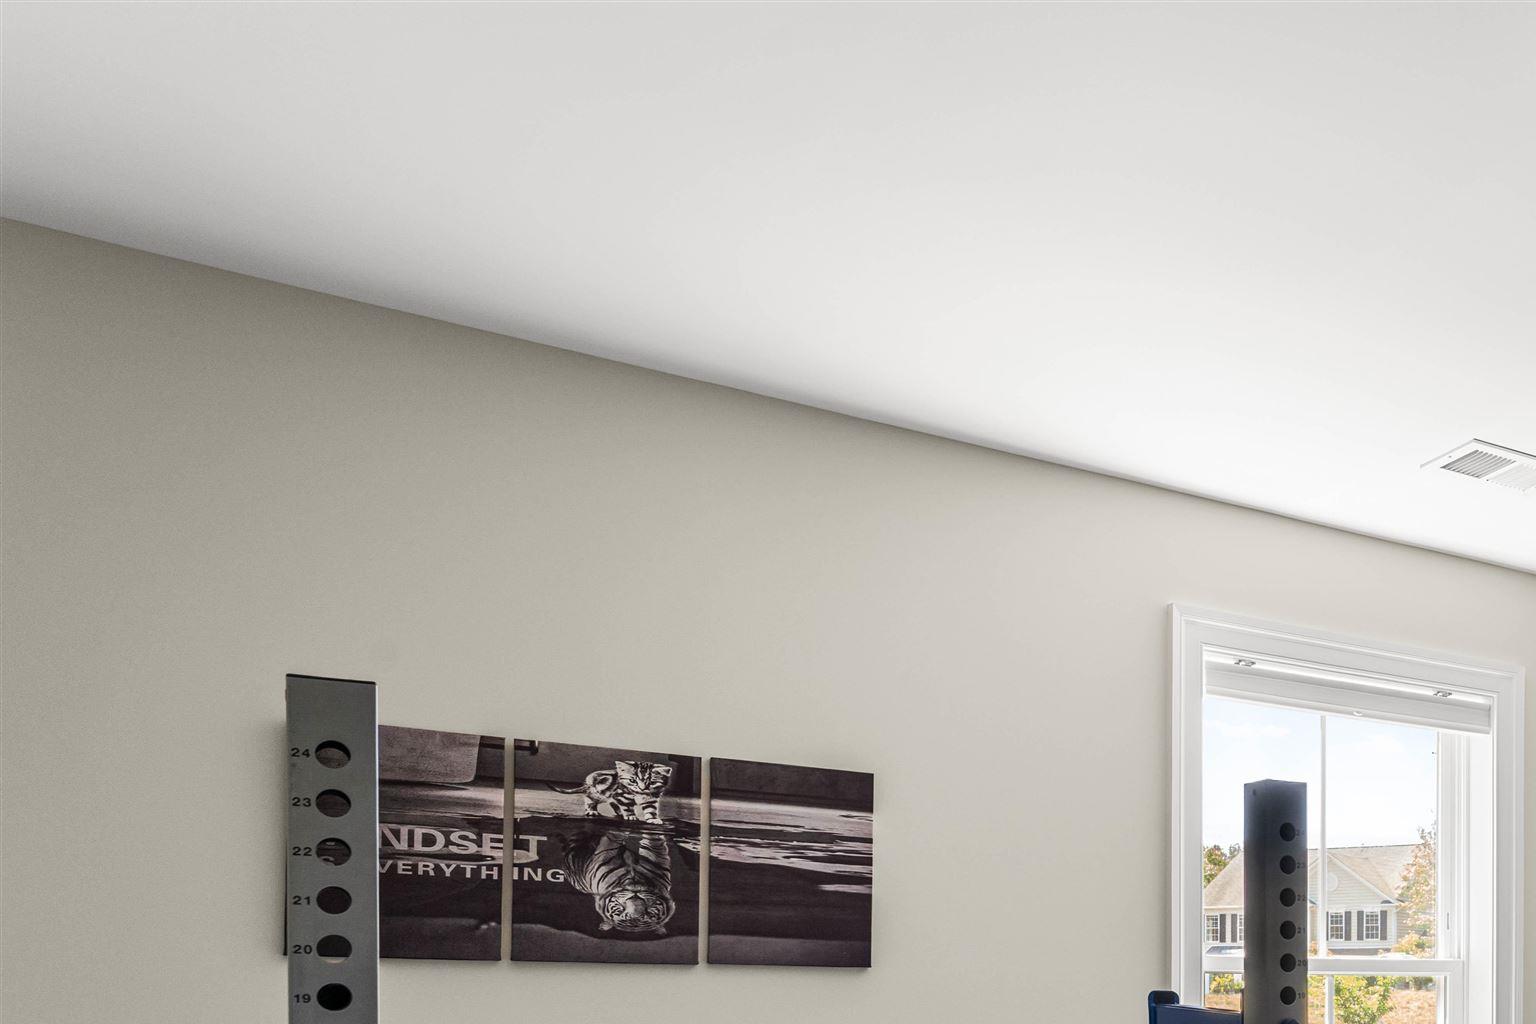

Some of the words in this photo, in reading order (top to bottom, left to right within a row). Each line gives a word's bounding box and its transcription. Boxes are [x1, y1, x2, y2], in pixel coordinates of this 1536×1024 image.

[291, 748, 311, 758] 24
[292, 797, 312, 807] 23
[379, 824, 547, 857] NDSET
[292, 847, 312, 857] 22
[379, 860, 565, 884] VERYTHING
[292, 895, 311, 905] 21
[292, 944, 313, 955] 20
[293, 993, 312, 1003] 19
